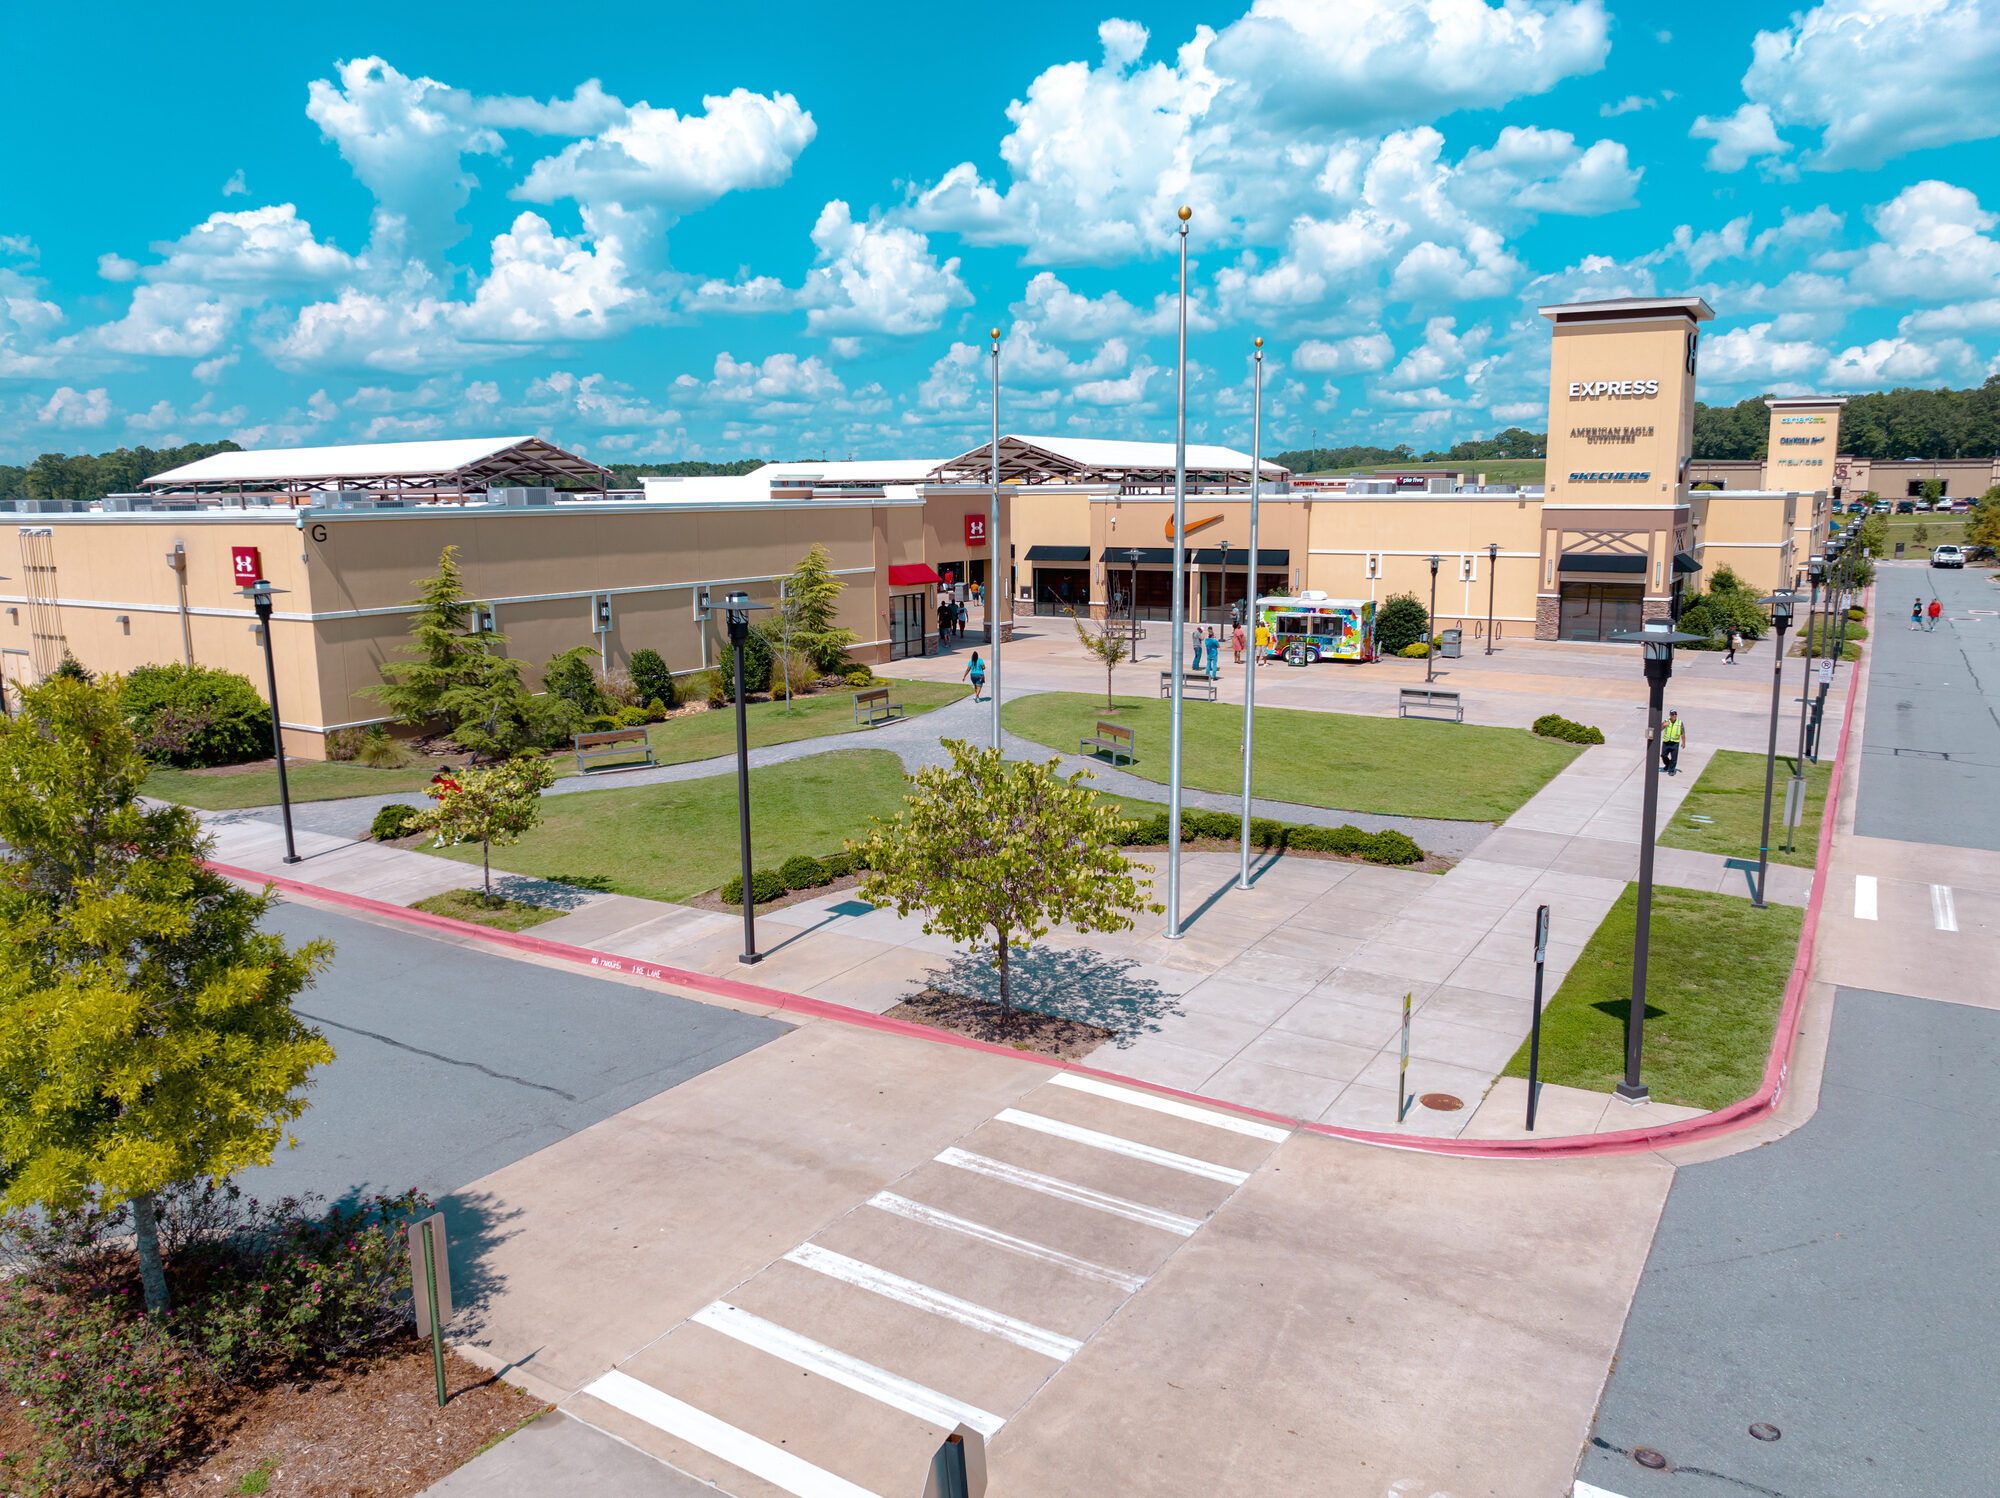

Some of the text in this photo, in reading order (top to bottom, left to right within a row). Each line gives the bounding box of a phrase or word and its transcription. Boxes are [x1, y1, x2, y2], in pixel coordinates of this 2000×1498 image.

[1569, 379, 1659, 398] EXPRESS
[1570, 426, 1655, 438] AMERICAN EAGLE
[1587, 434, 1636, 445] OUTFITTERS
[1569, 471, 1651, 482] SKECHERS
[312, 524, 327, 542] G
